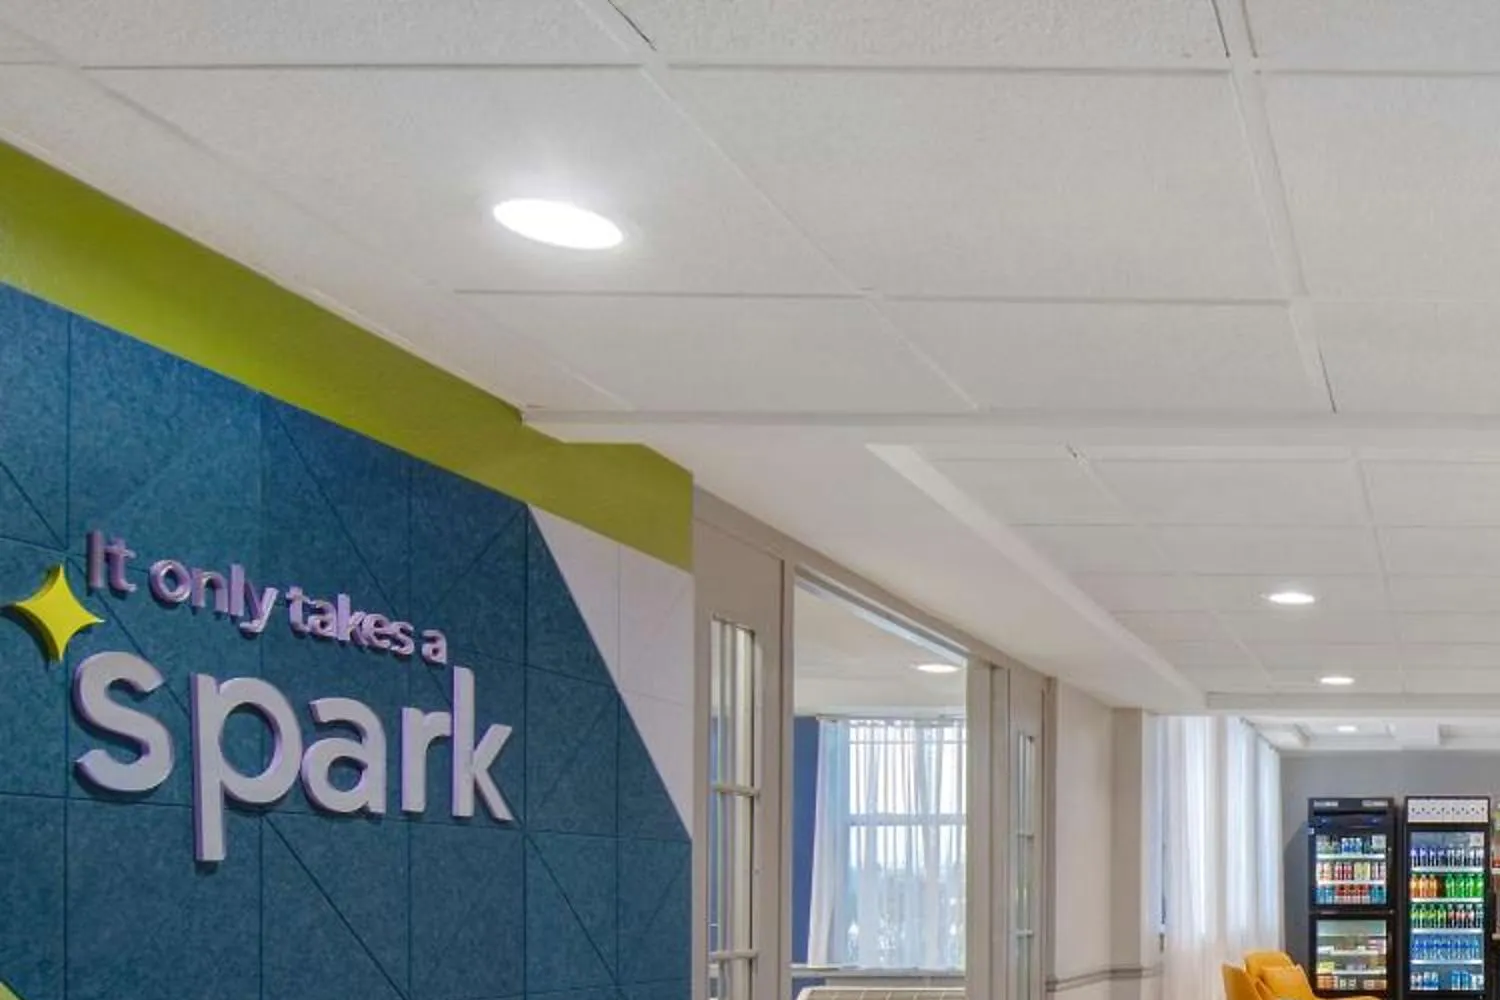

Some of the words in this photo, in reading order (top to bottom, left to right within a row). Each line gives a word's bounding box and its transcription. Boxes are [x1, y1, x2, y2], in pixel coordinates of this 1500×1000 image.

[87, 530, 136, 593] It
[150, 559, 278, 634] only
[286, 586, 414, 655] takes
[422, 629, 448, 664] a
[73, 651, 513, 863] spark
